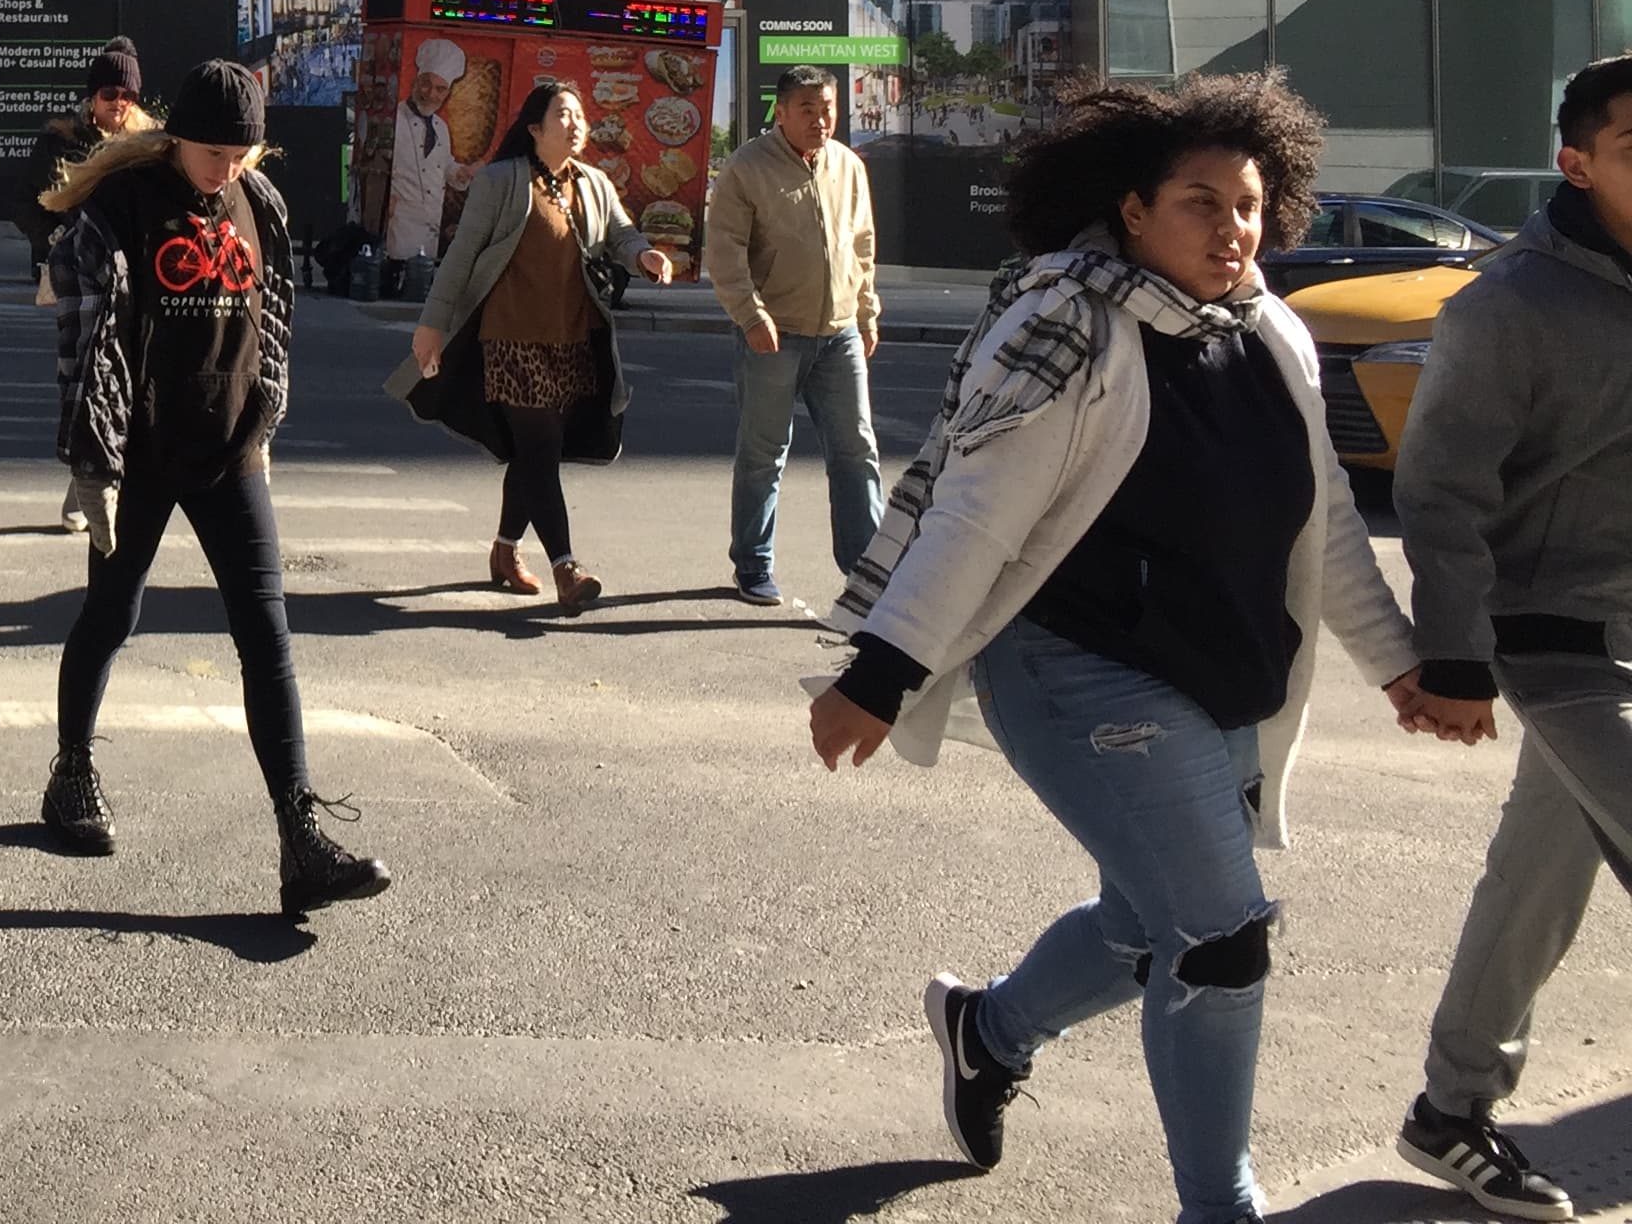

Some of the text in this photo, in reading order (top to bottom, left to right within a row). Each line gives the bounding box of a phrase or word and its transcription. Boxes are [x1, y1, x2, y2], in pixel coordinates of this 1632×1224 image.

[759, 20, 833, 31] COMING SOON
[43, 46, 80, 59] Dining
[766, 43, 900, 57] MANHATTAN WEST
[19, 58, 56, 68] Casual
[59, 58, 86, 68] Food
[33, 90, 66, 103] Space
[68, 90, 78, 101] &
[160, 296, 250, 307] COPENHAGEN
